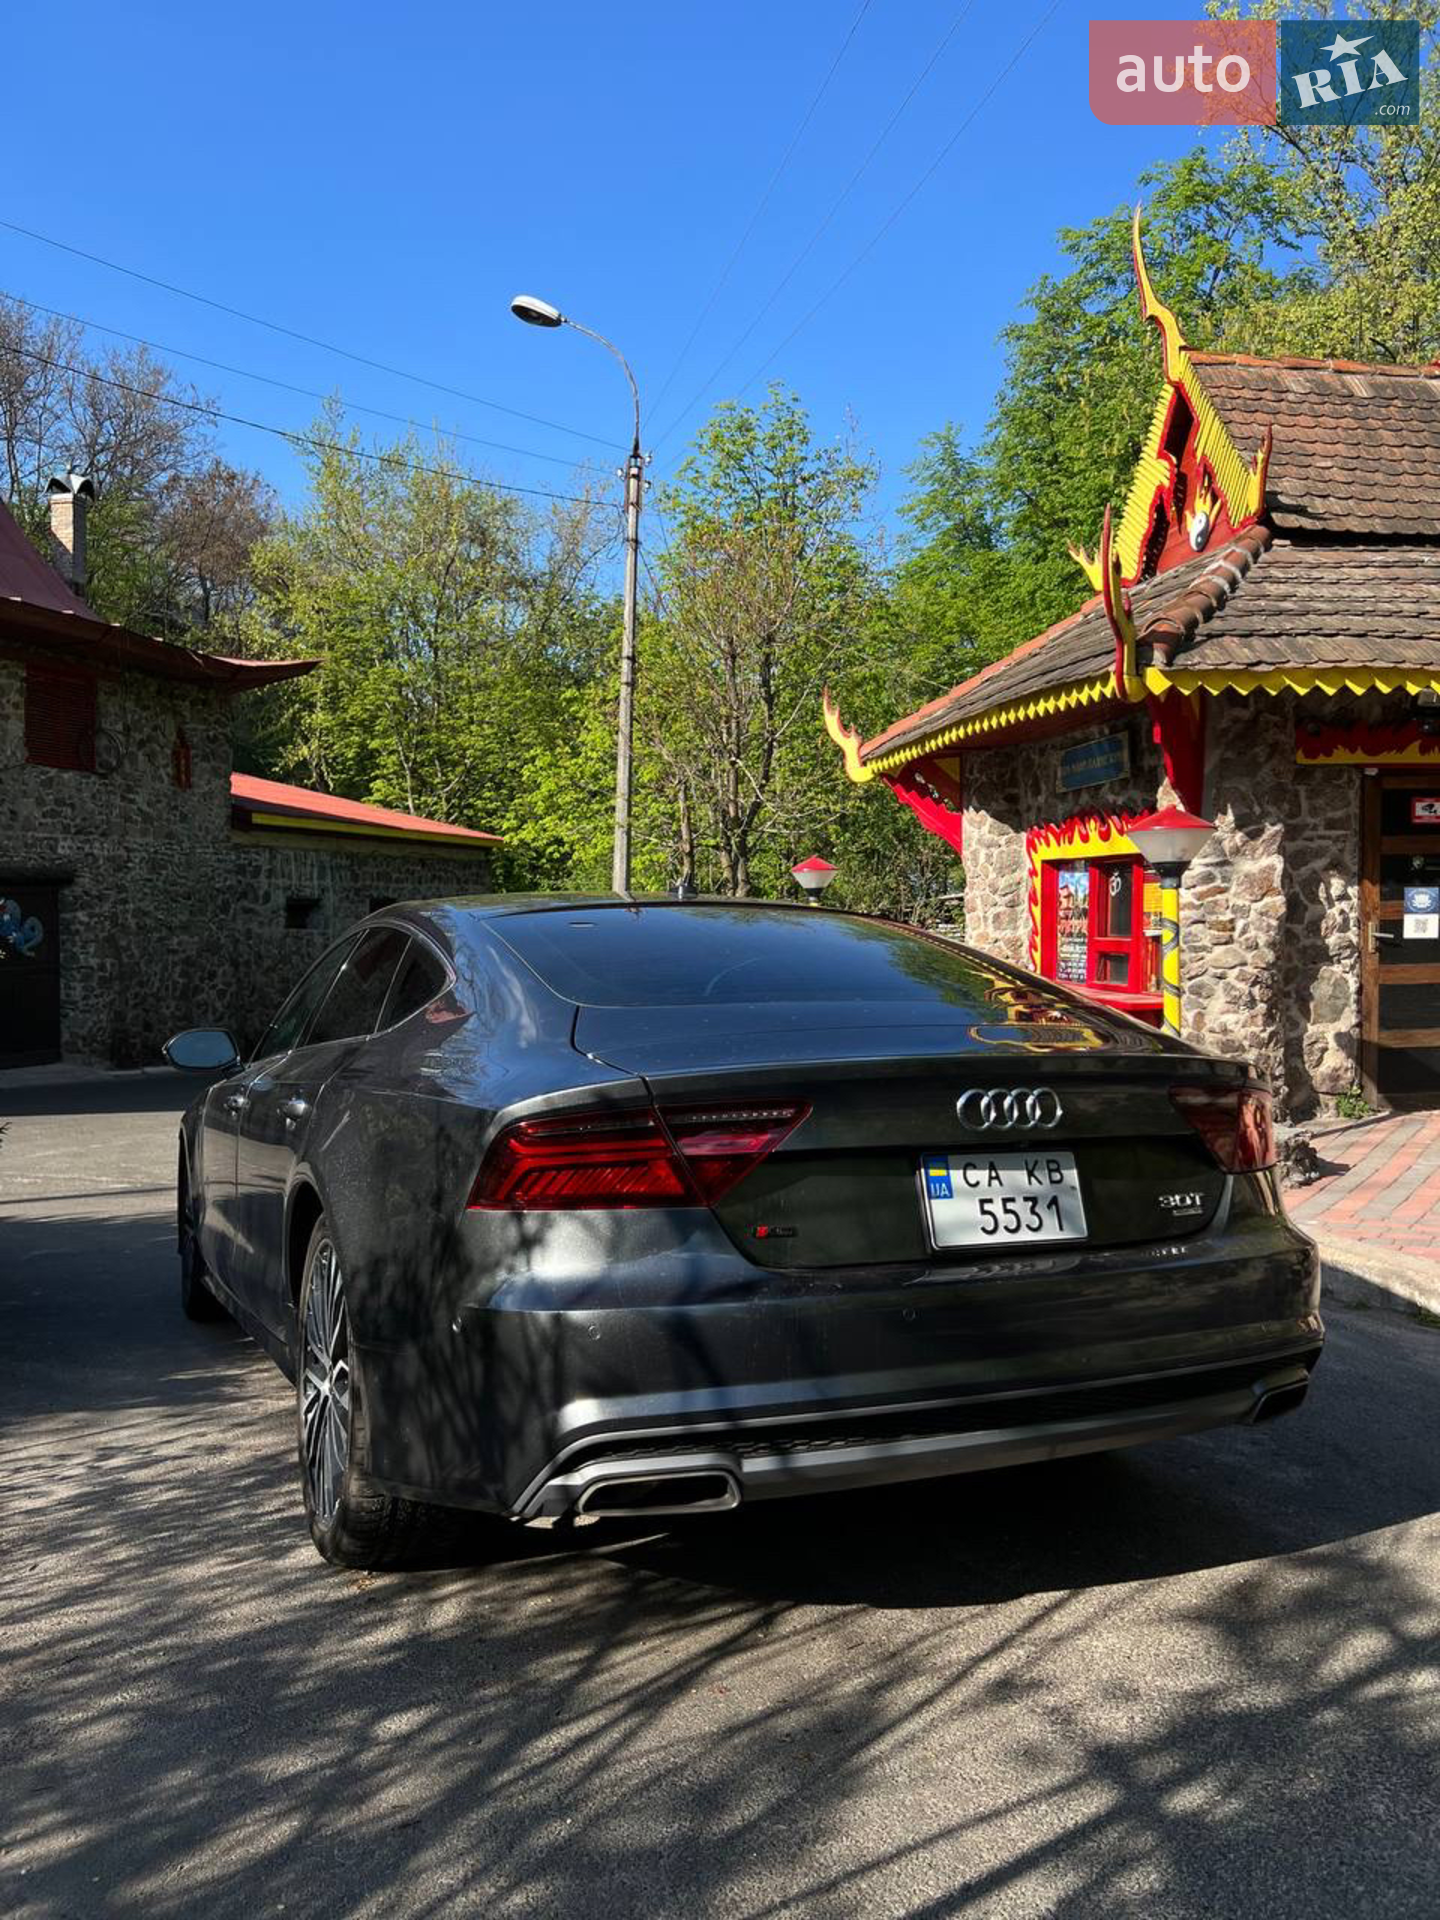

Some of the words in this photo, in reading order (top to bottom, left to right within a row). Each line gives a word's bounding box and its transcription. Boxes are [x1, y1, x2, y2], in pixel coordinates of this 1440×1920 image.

[962, 1160, 1003, 1187] CA
[1024, 1159, 1064, 1186] KB
[930, 1183, 950, 1197] UA
[978, 1195, 1064, 1235] 5531
